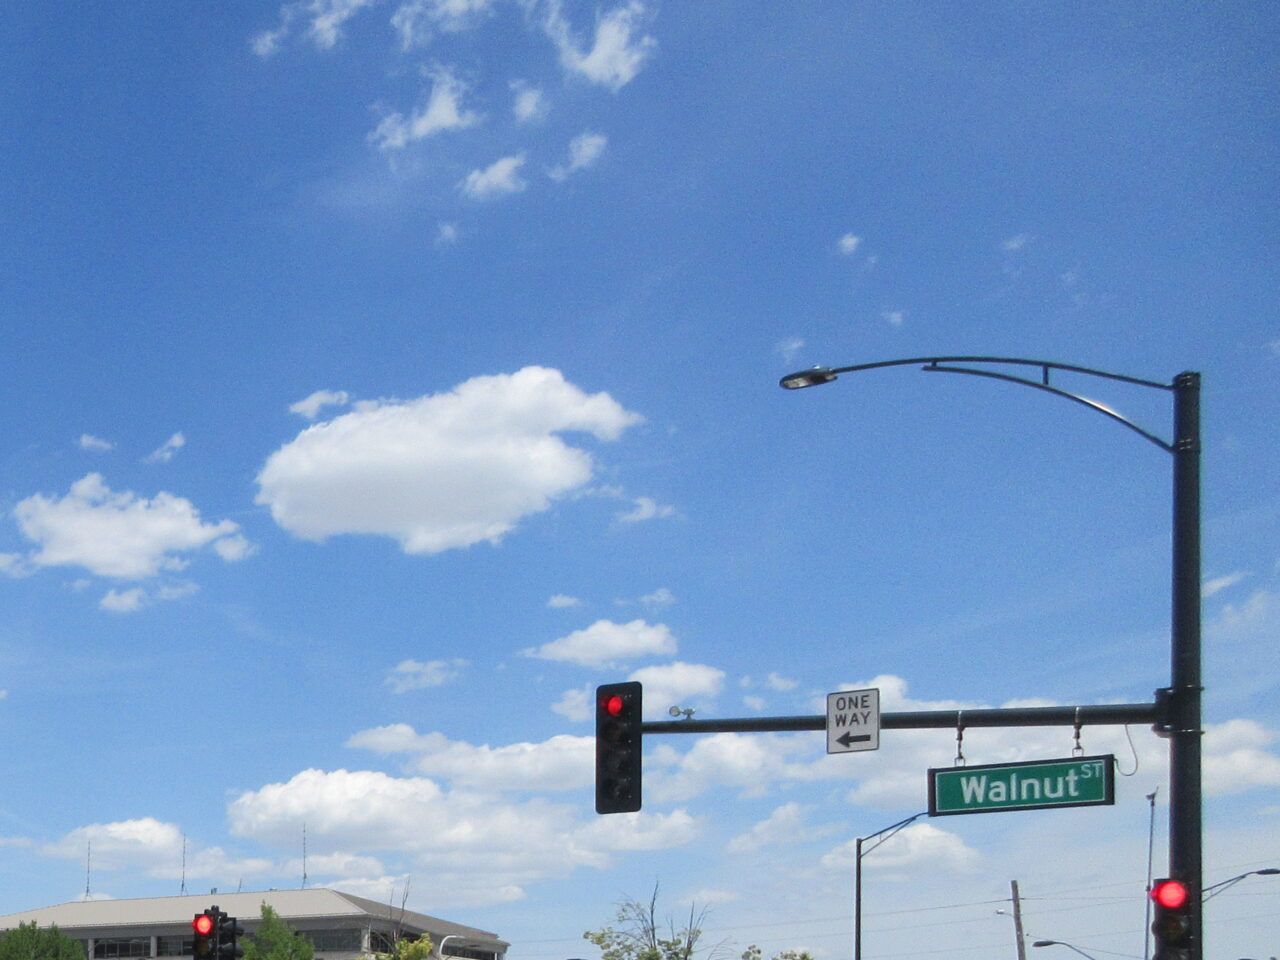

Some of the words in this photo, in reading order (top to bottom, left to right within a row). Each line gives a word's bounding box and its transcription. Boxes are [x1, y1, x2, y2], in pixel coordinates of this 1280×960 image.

[836, 694, 870, 711] ONE
[835, 710, 872, 728] WAY
[959, 768, 1079, 804] Walnut
[1080, 762, 1103, 779] ST
